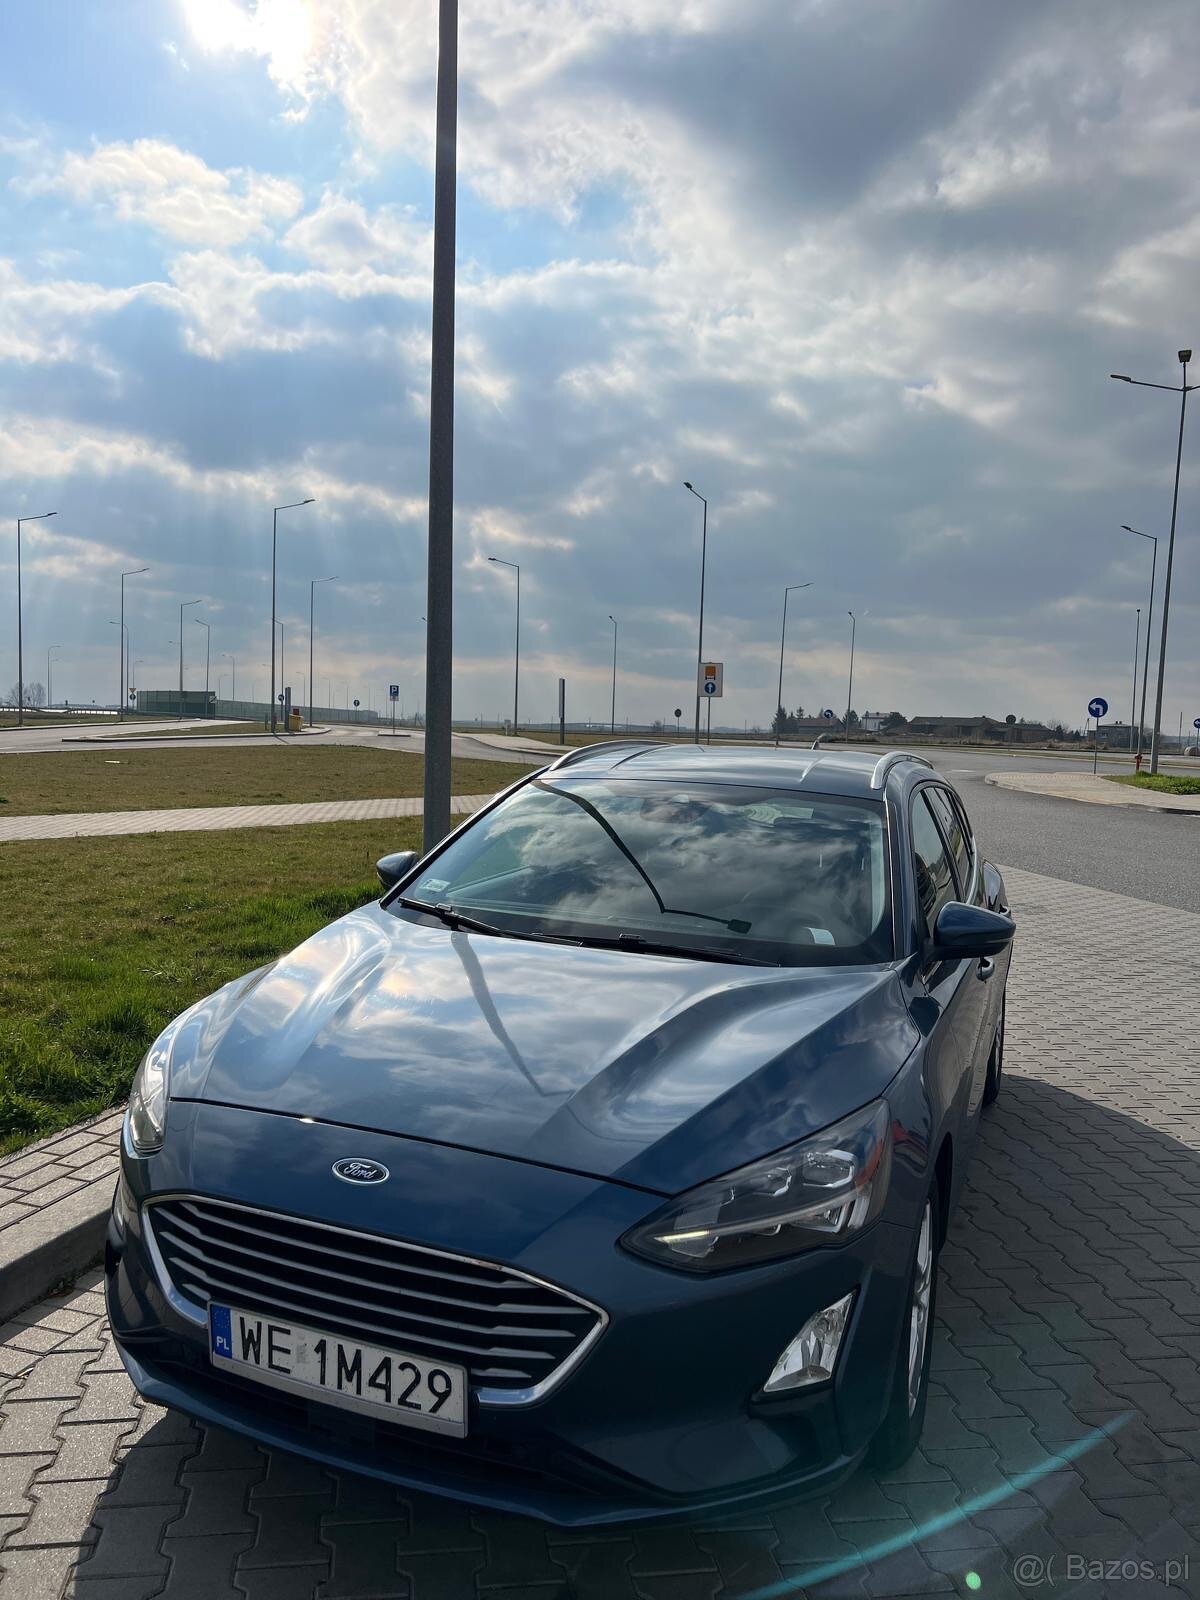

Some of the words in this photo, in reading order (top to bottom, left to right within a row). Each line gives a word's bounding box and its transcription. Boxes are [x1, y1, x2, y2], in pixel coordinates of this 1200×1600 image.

[343, 1162, 378, 1180] Ford
[216, 1335, 230, 1350] PL
[239, 1316, 291, 1375] WE
[313, 1338, 452, 1414] 1M429
